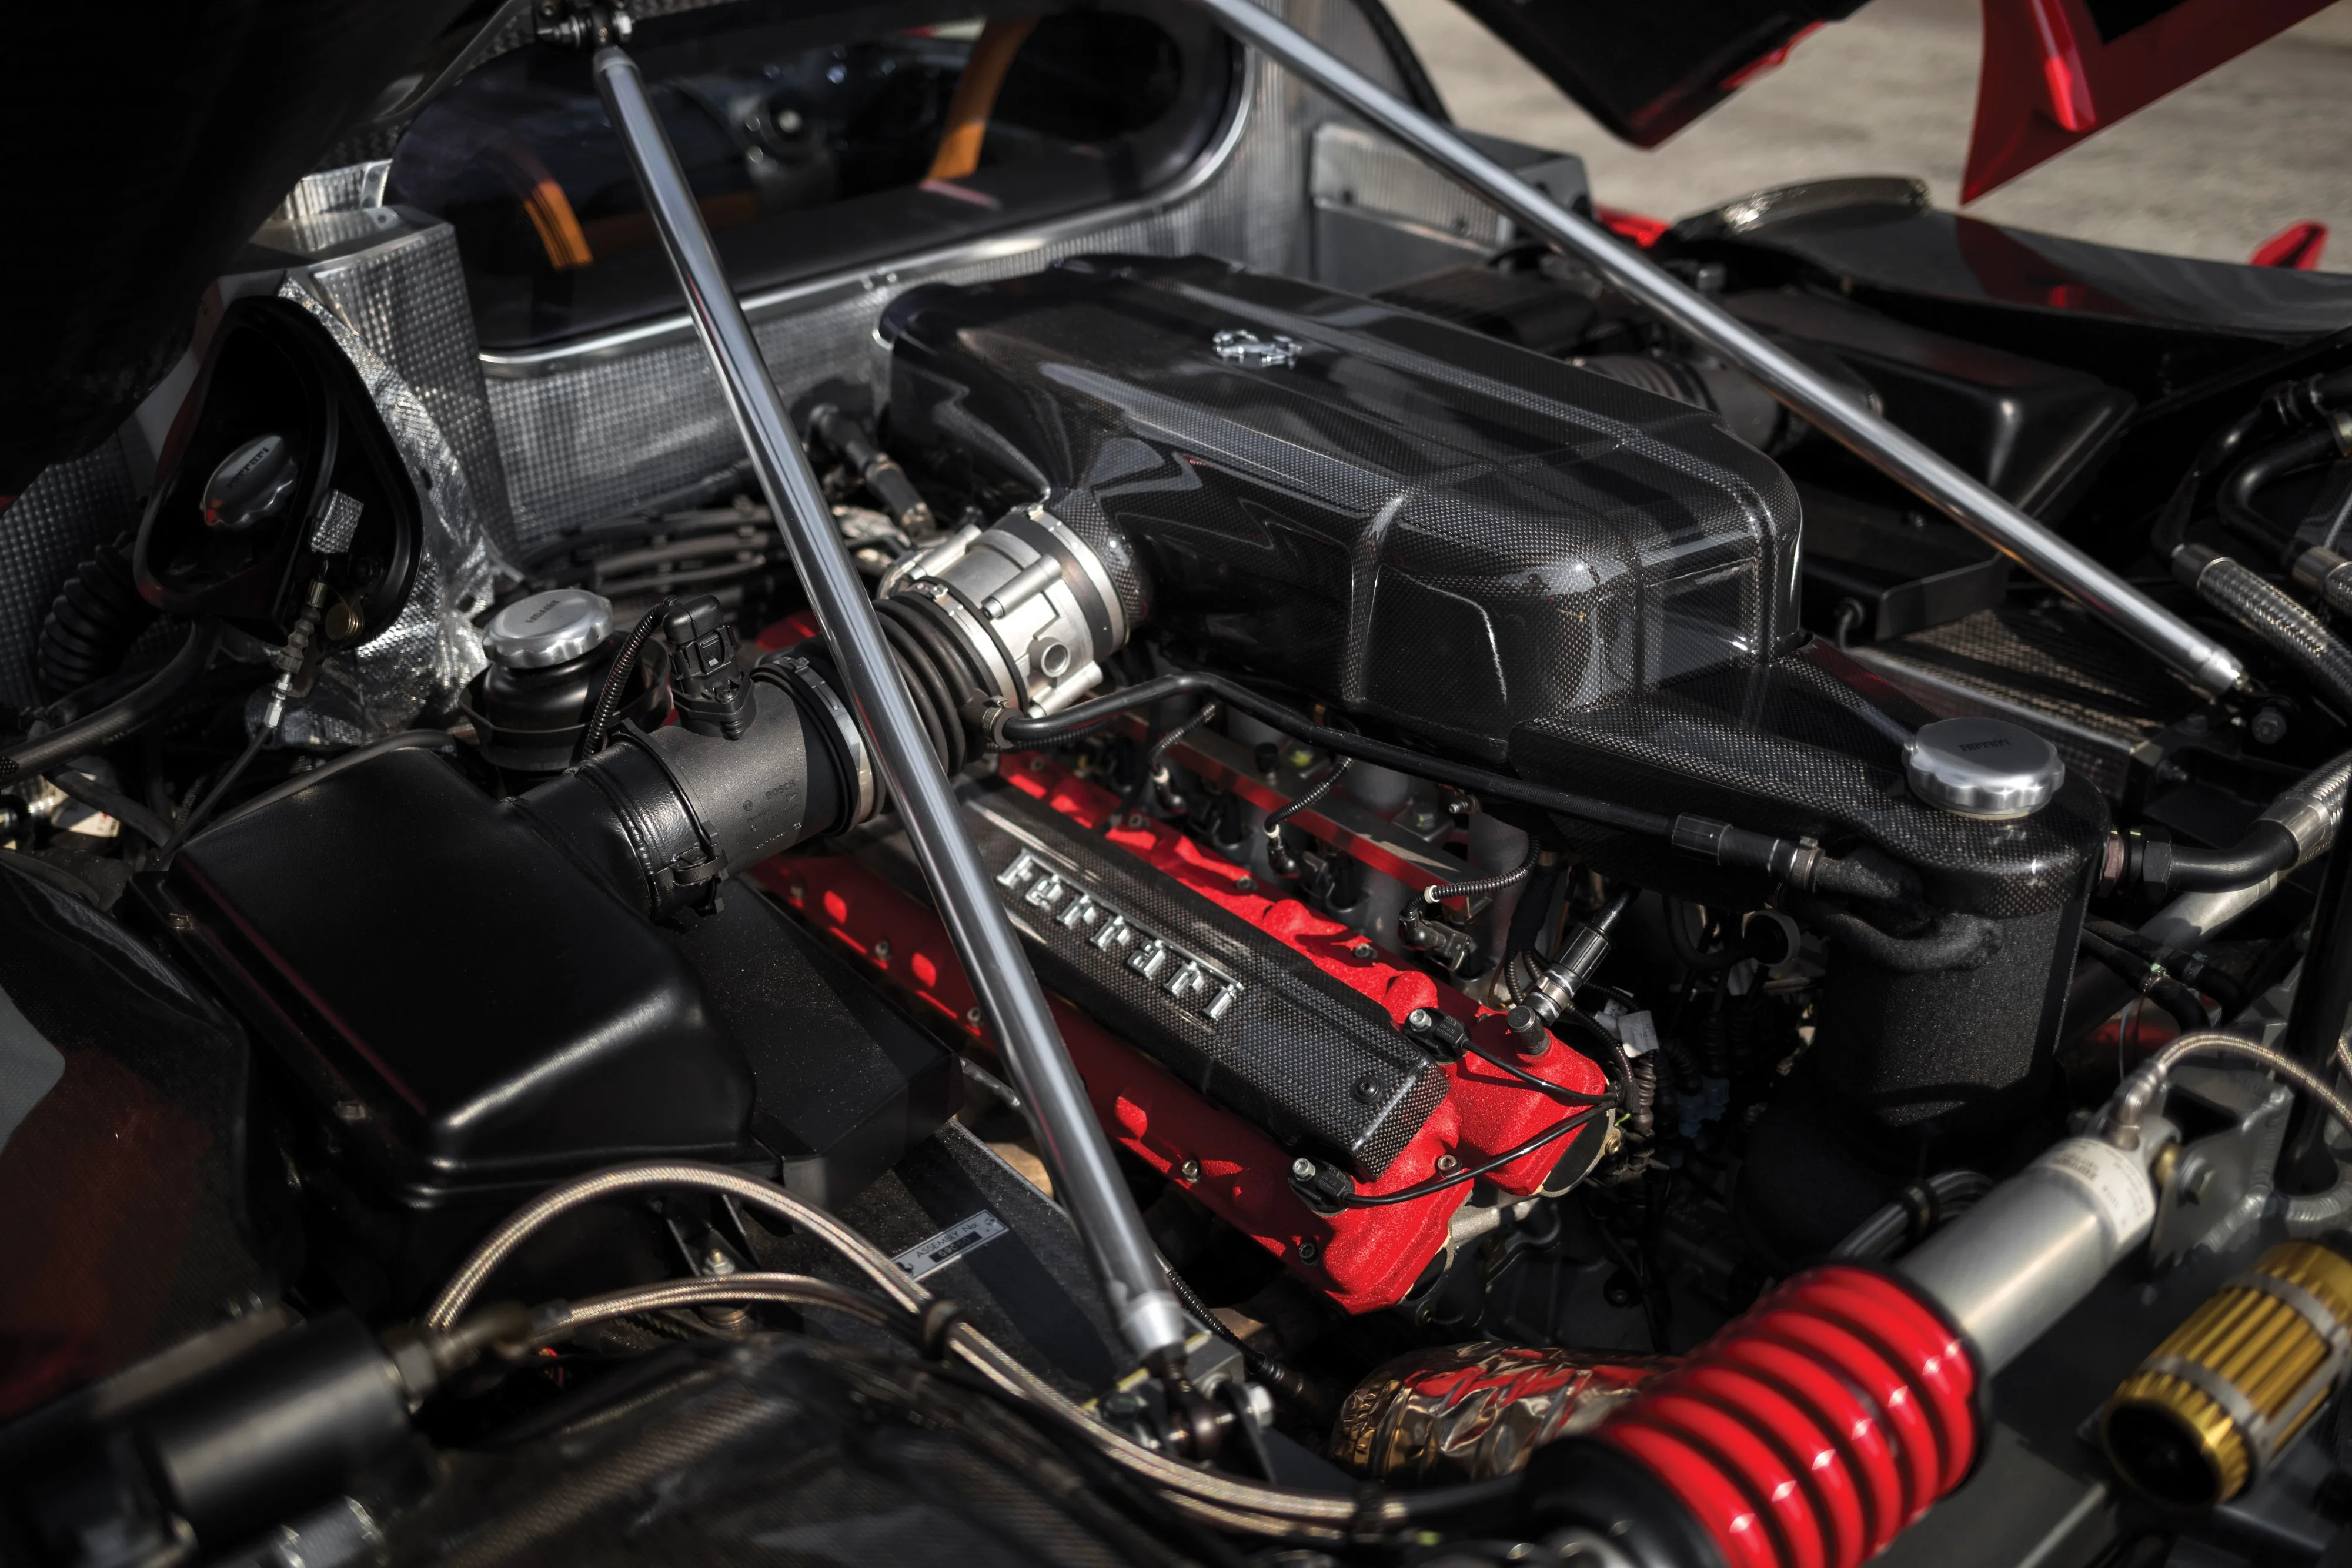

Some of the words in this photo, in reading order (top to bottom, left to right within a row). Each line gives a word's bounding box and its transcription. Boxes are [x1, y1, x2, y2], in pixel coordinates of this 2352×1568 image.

[765, 779, 796, 800] BOSCH
[995, 847, 1245, 1021] Ferrari
[916, 1230, 960, 1258] ASSEMBLY
[938, 1237, 971, 1257] 59050
